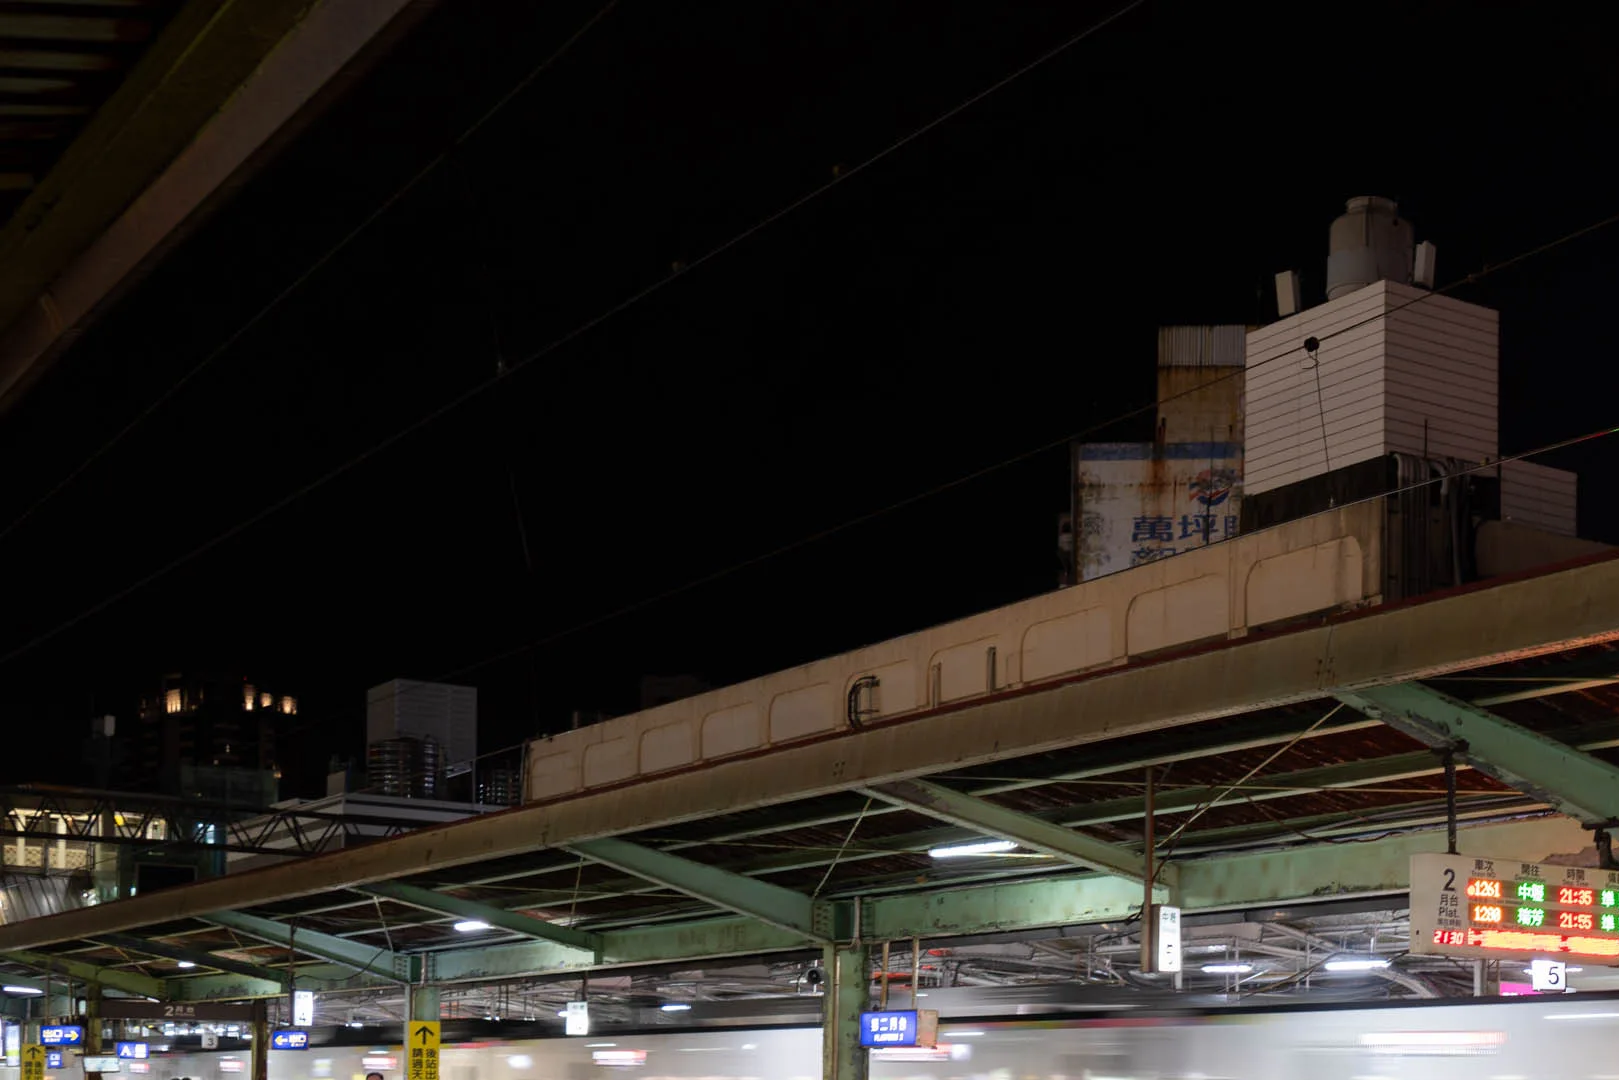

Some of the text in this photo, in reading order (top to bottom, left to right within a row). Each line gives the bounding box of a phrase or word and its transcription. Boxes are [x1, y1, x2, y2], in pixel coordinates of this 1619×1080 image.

[1443, 868, 1456, 892] 2
[1473, 879, 1501, 898] 1261
[1440, 894, 1458, 907] 月台
[1559, 887, 1593, 906] 21:35
[1559, 912, 1593, 930] 21:55
[1548, 966, 1560, 985] 5
[207, 1038, 214, 1047] 3
